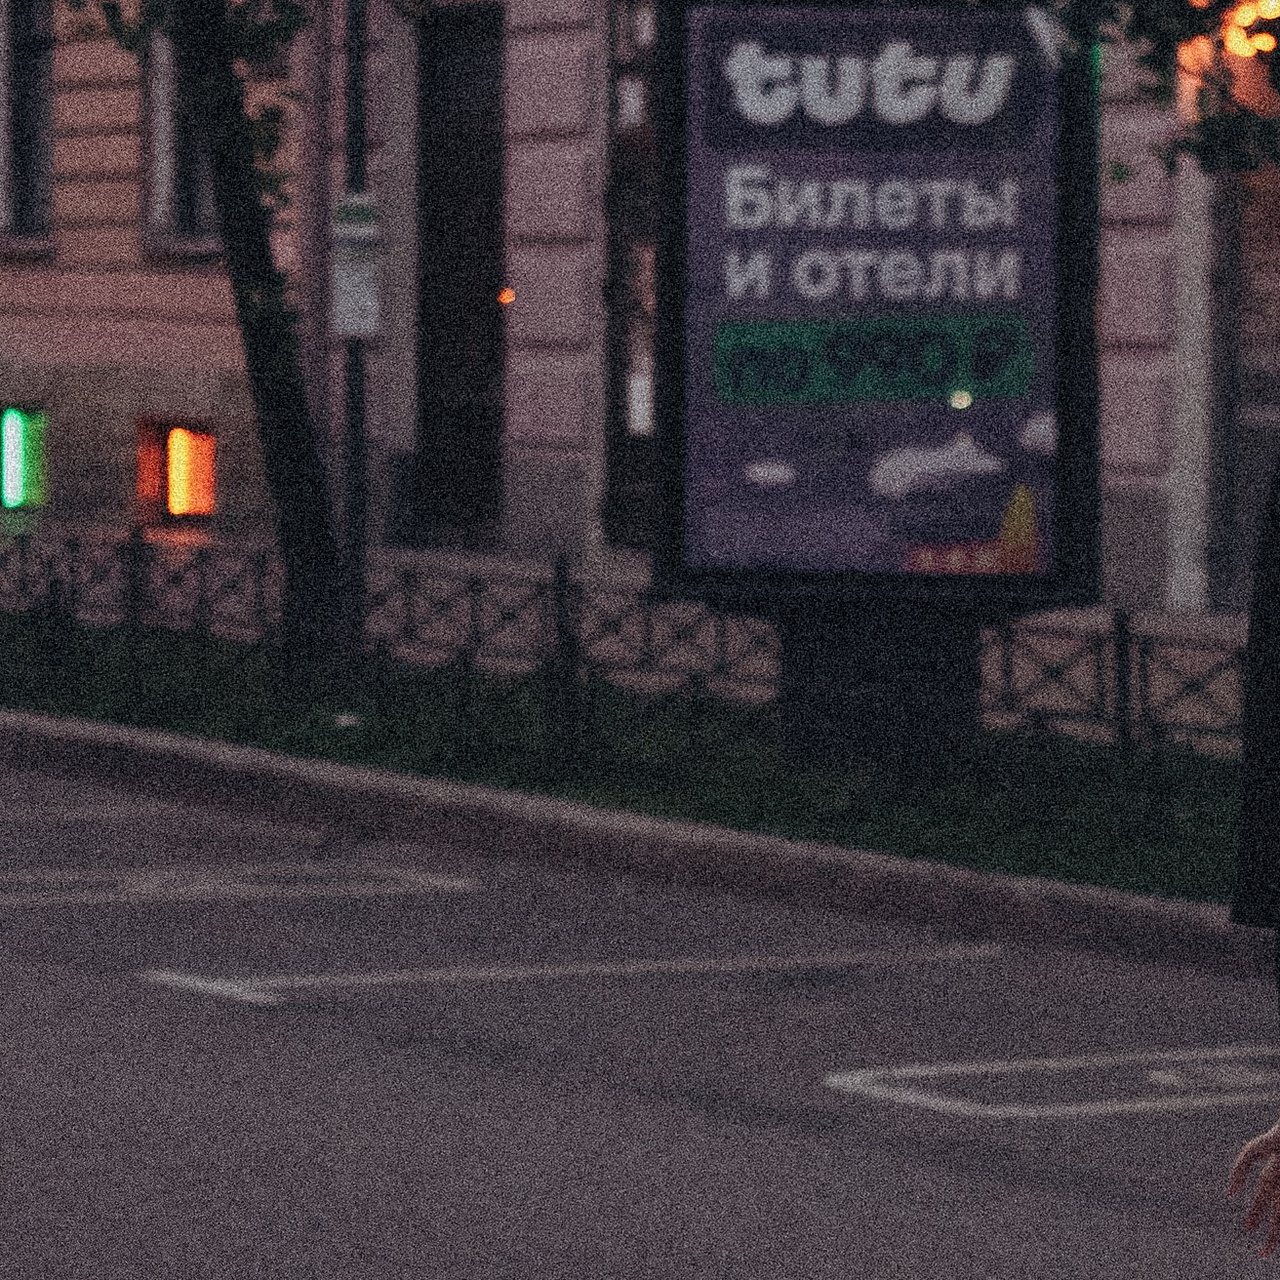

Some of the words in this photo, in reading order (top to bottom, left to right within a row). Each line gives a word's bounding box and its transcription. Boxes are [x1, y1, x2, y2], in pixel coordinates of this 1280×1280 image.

[726, 40, 1015, 125] tutu
[726, 166, 1020, 230] Билеты
[726, 250, 771, 300] и
[793, 249, 1020, 300] отели
